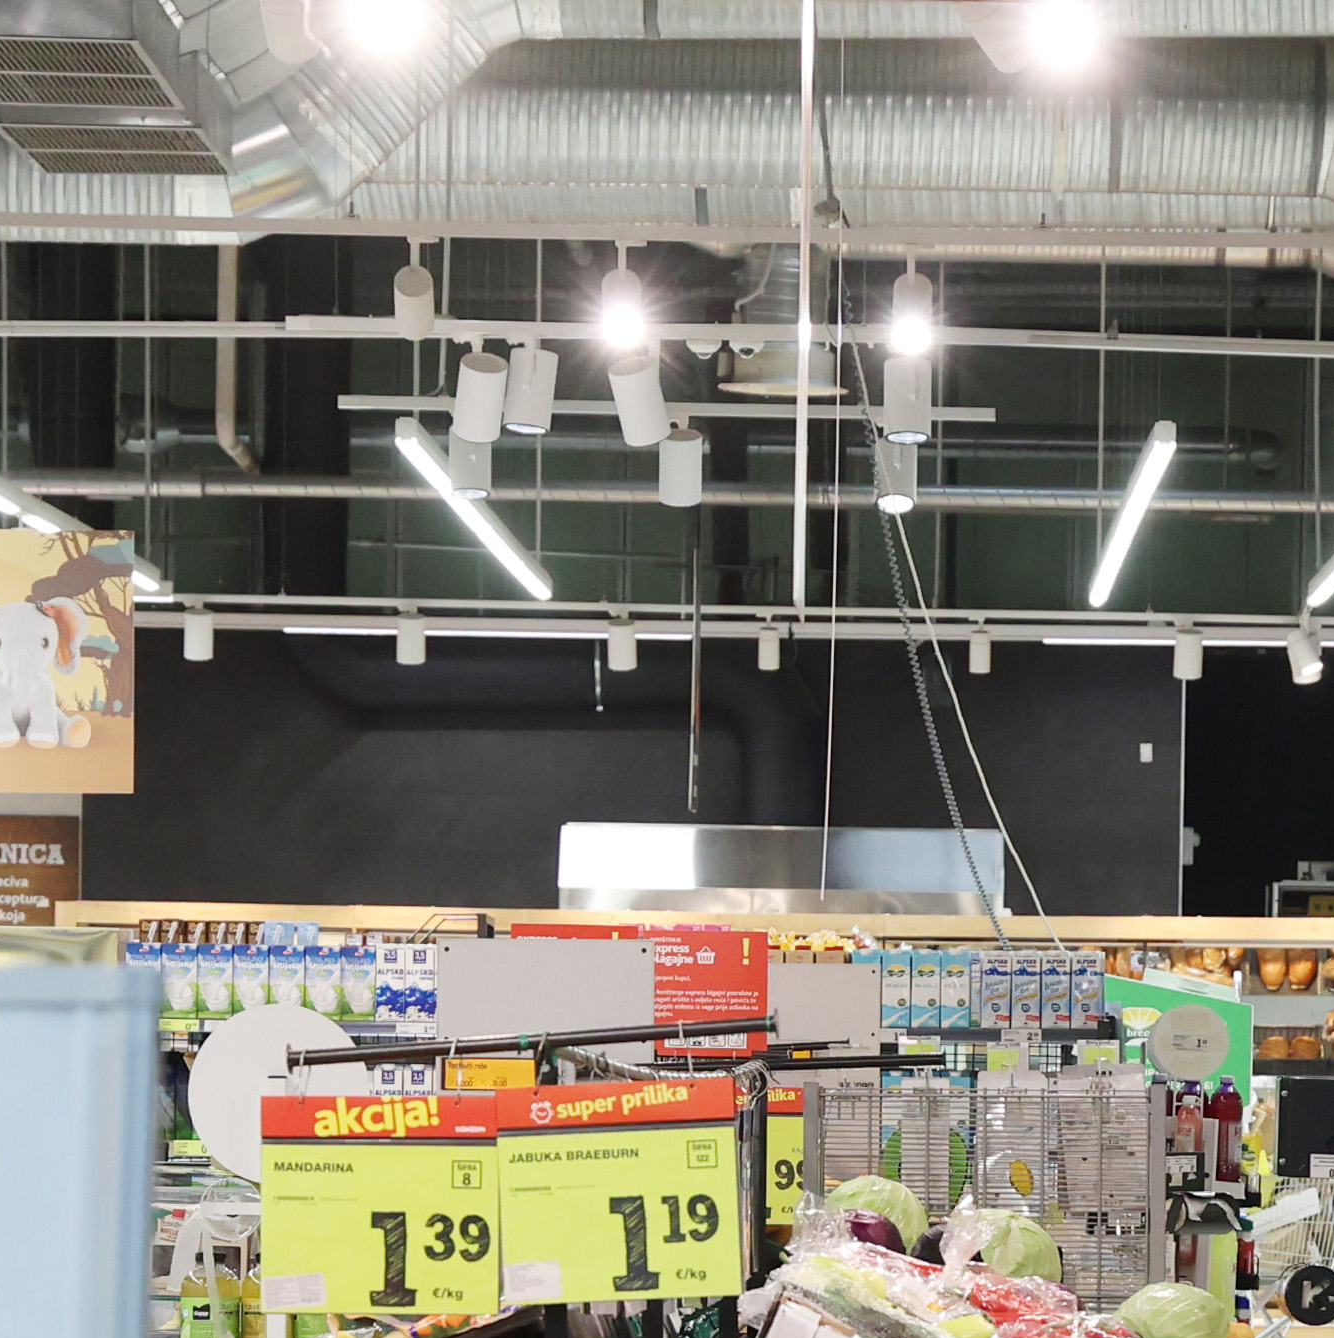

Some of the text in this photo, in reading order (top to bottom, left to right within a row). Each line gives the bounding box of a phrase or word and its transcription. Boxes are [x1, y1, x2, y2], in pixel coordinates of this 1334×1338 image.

[0, 909, 26, 923] koja
[556, 1083, 689, 1121] super prilika
[313, 1096, 441, 1137] akcija!
[509, 1148, 639, 1164] JABUKA BRAEBURN
[273, 1161, 354, 1173] MANDARINA
[462, 1173, 471, 1186] 8
[609, 1195, 660, 1292] 1
[661, 1194, 720, 1244] 19
[369, 1211, 418, 1307] 1
[423, 1213, 491, 1262] 39
[675, 1269, 708, 1281] €/kg
[432, 1288, 464, 1301] €/kg
